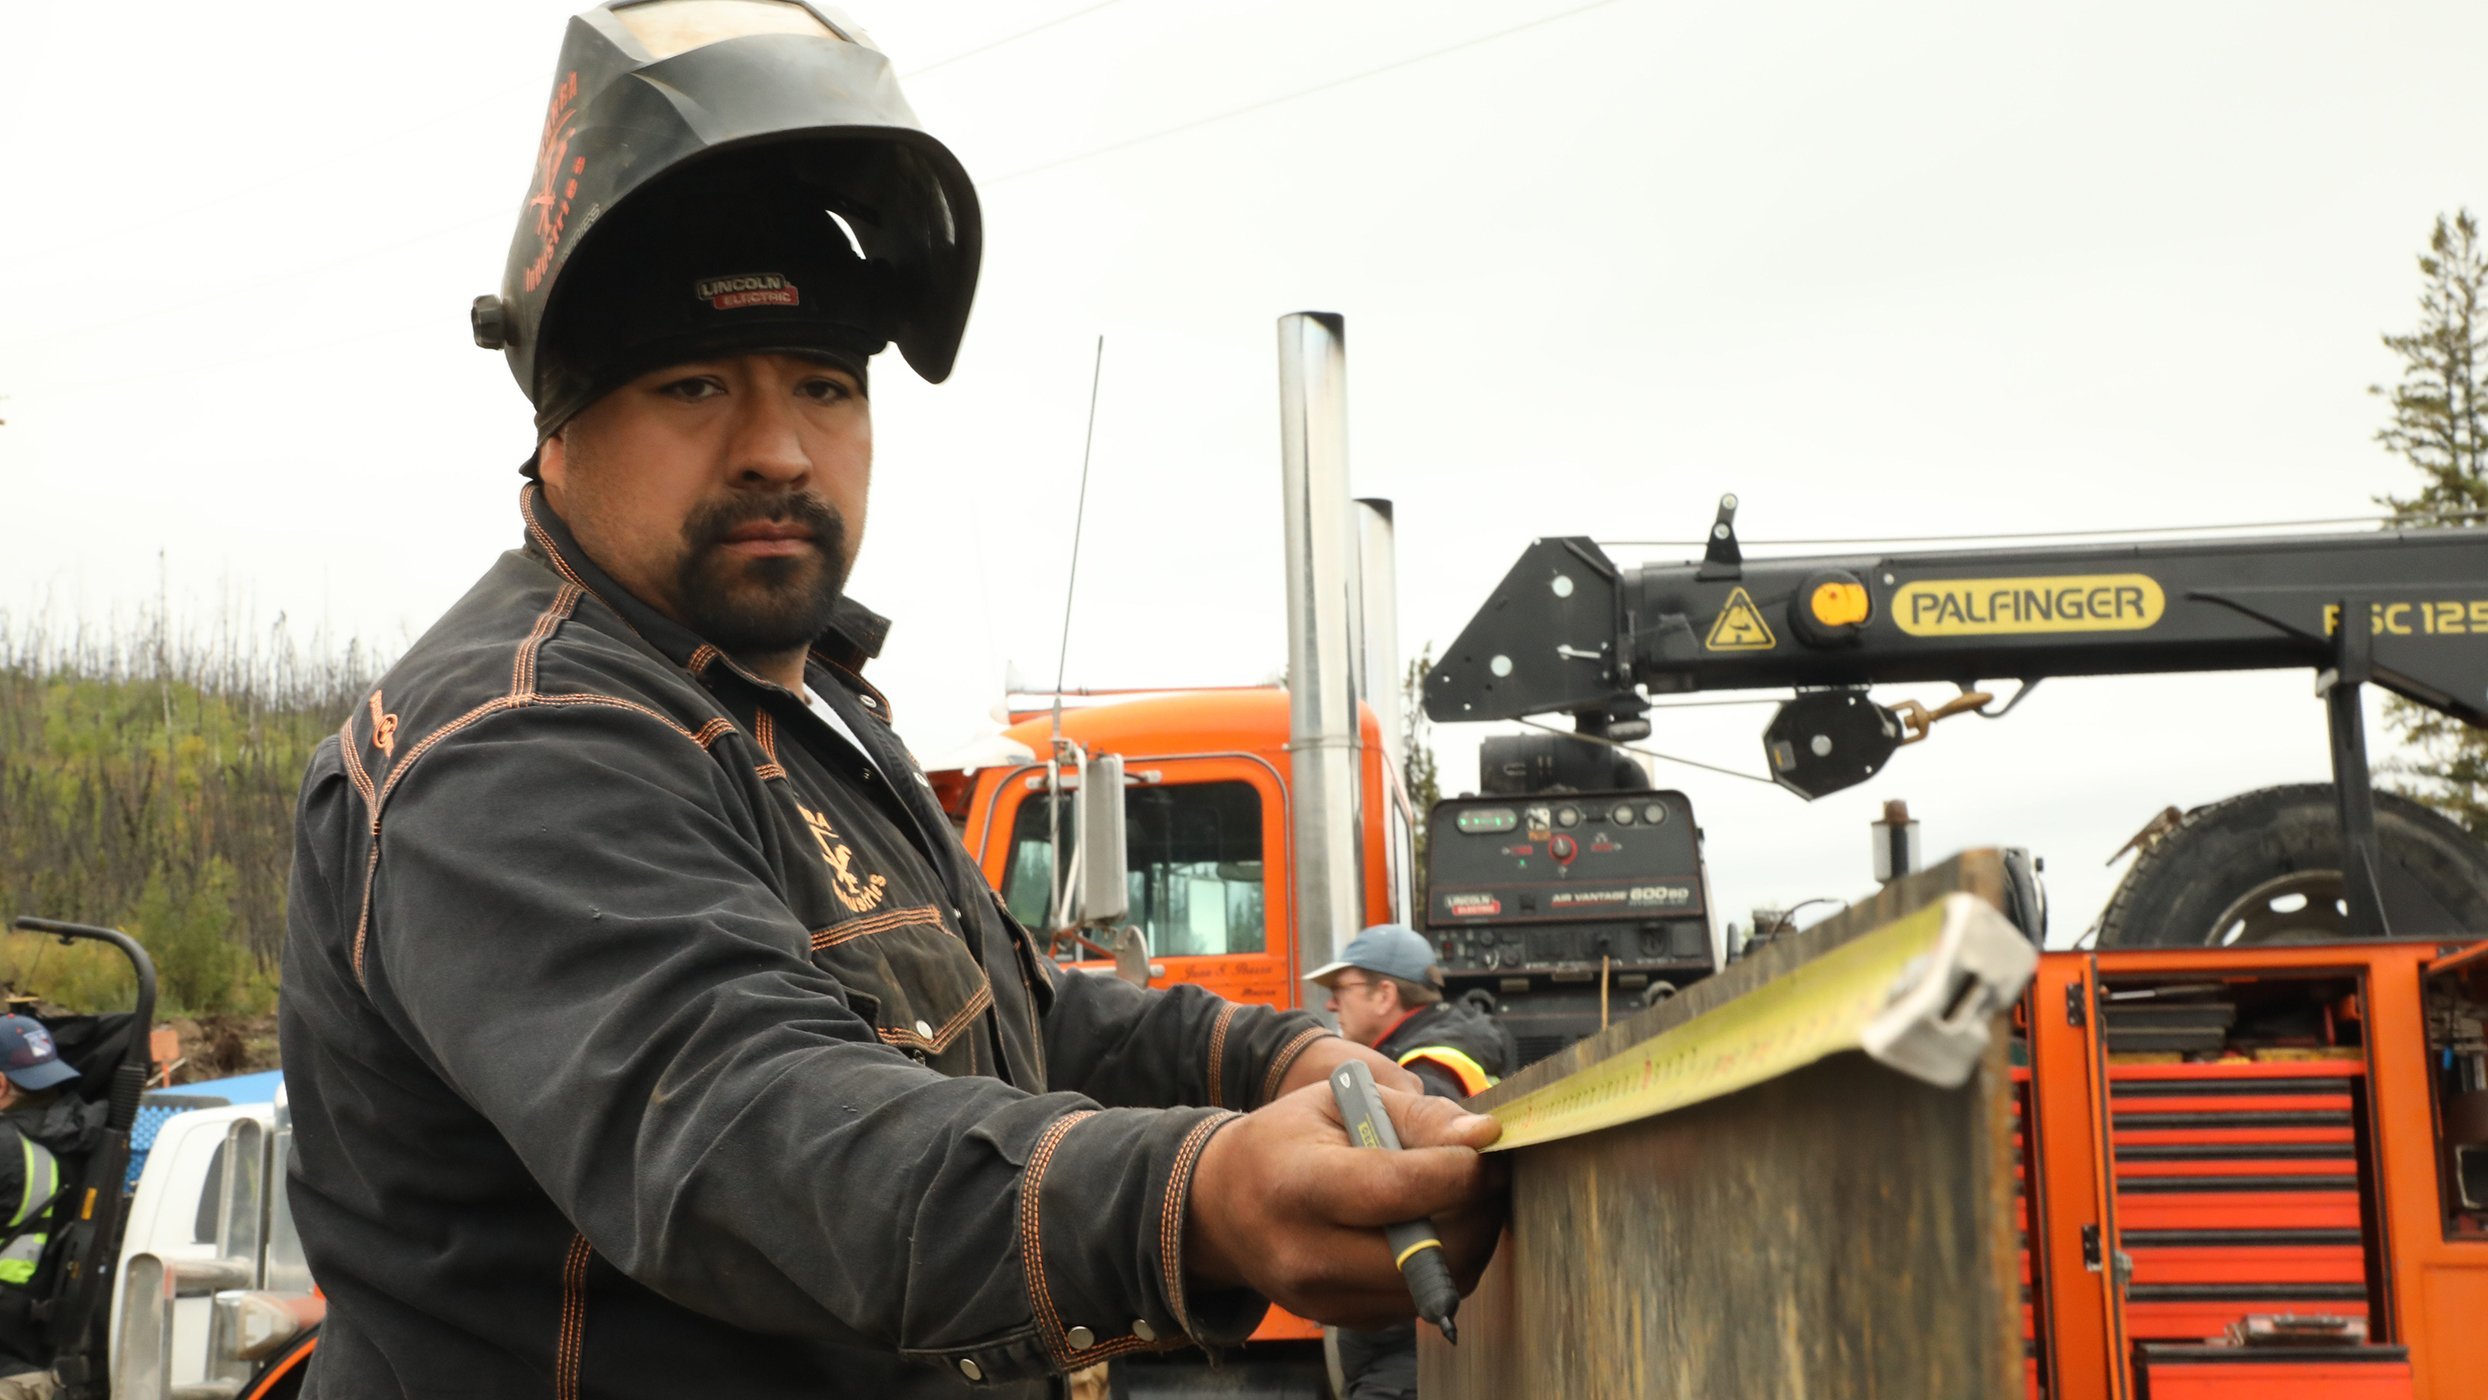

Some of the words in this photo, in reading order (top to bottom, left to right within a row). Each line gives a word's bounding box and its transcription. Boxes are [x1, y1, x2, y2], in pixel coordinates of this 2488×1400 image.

[702, 277, 780, 297] LINCOLN
[724, 291, 792, 305] ELECTRIC
[1911, 587, 2148, 625] PALFINGER
